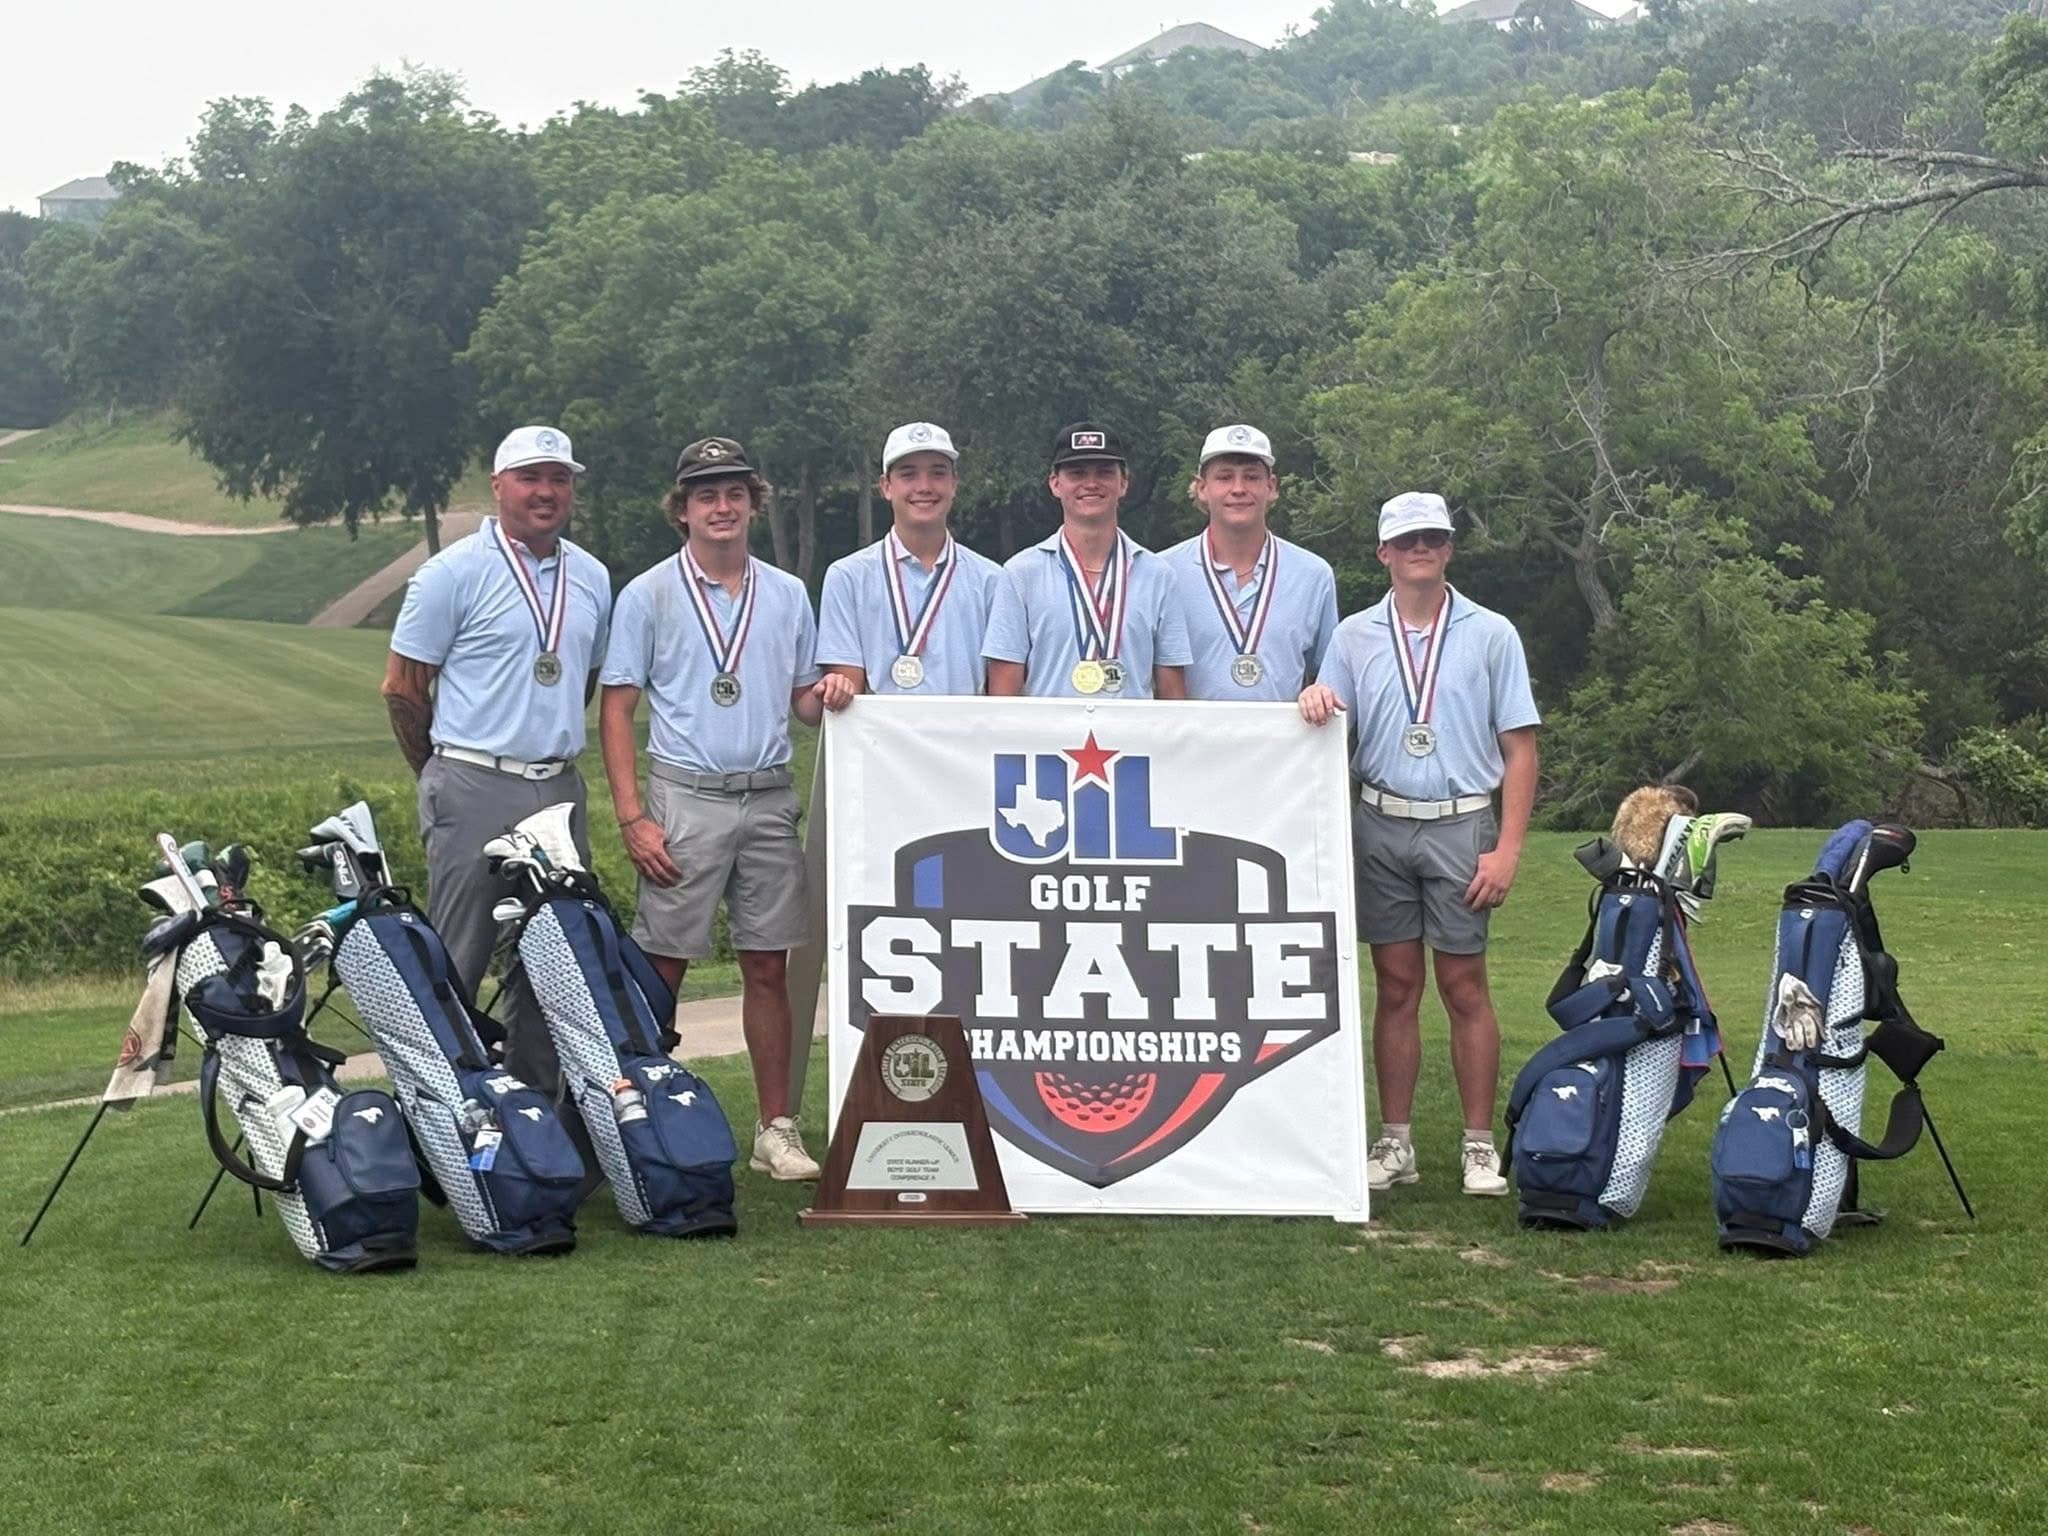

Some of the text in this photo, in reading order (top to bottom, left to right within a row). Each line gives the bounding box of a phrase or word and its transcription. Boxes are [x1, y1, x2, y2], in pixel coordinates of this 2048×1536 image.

[993, 729, 1178, 860] UIL
[333, 850, 353, 886] PING
[1030, 875, 1151, 912] GOLF
[861, 916, 1326, 1020] STATE
[963, 1029, 1241, 1063] HAMPIONSHIPS
